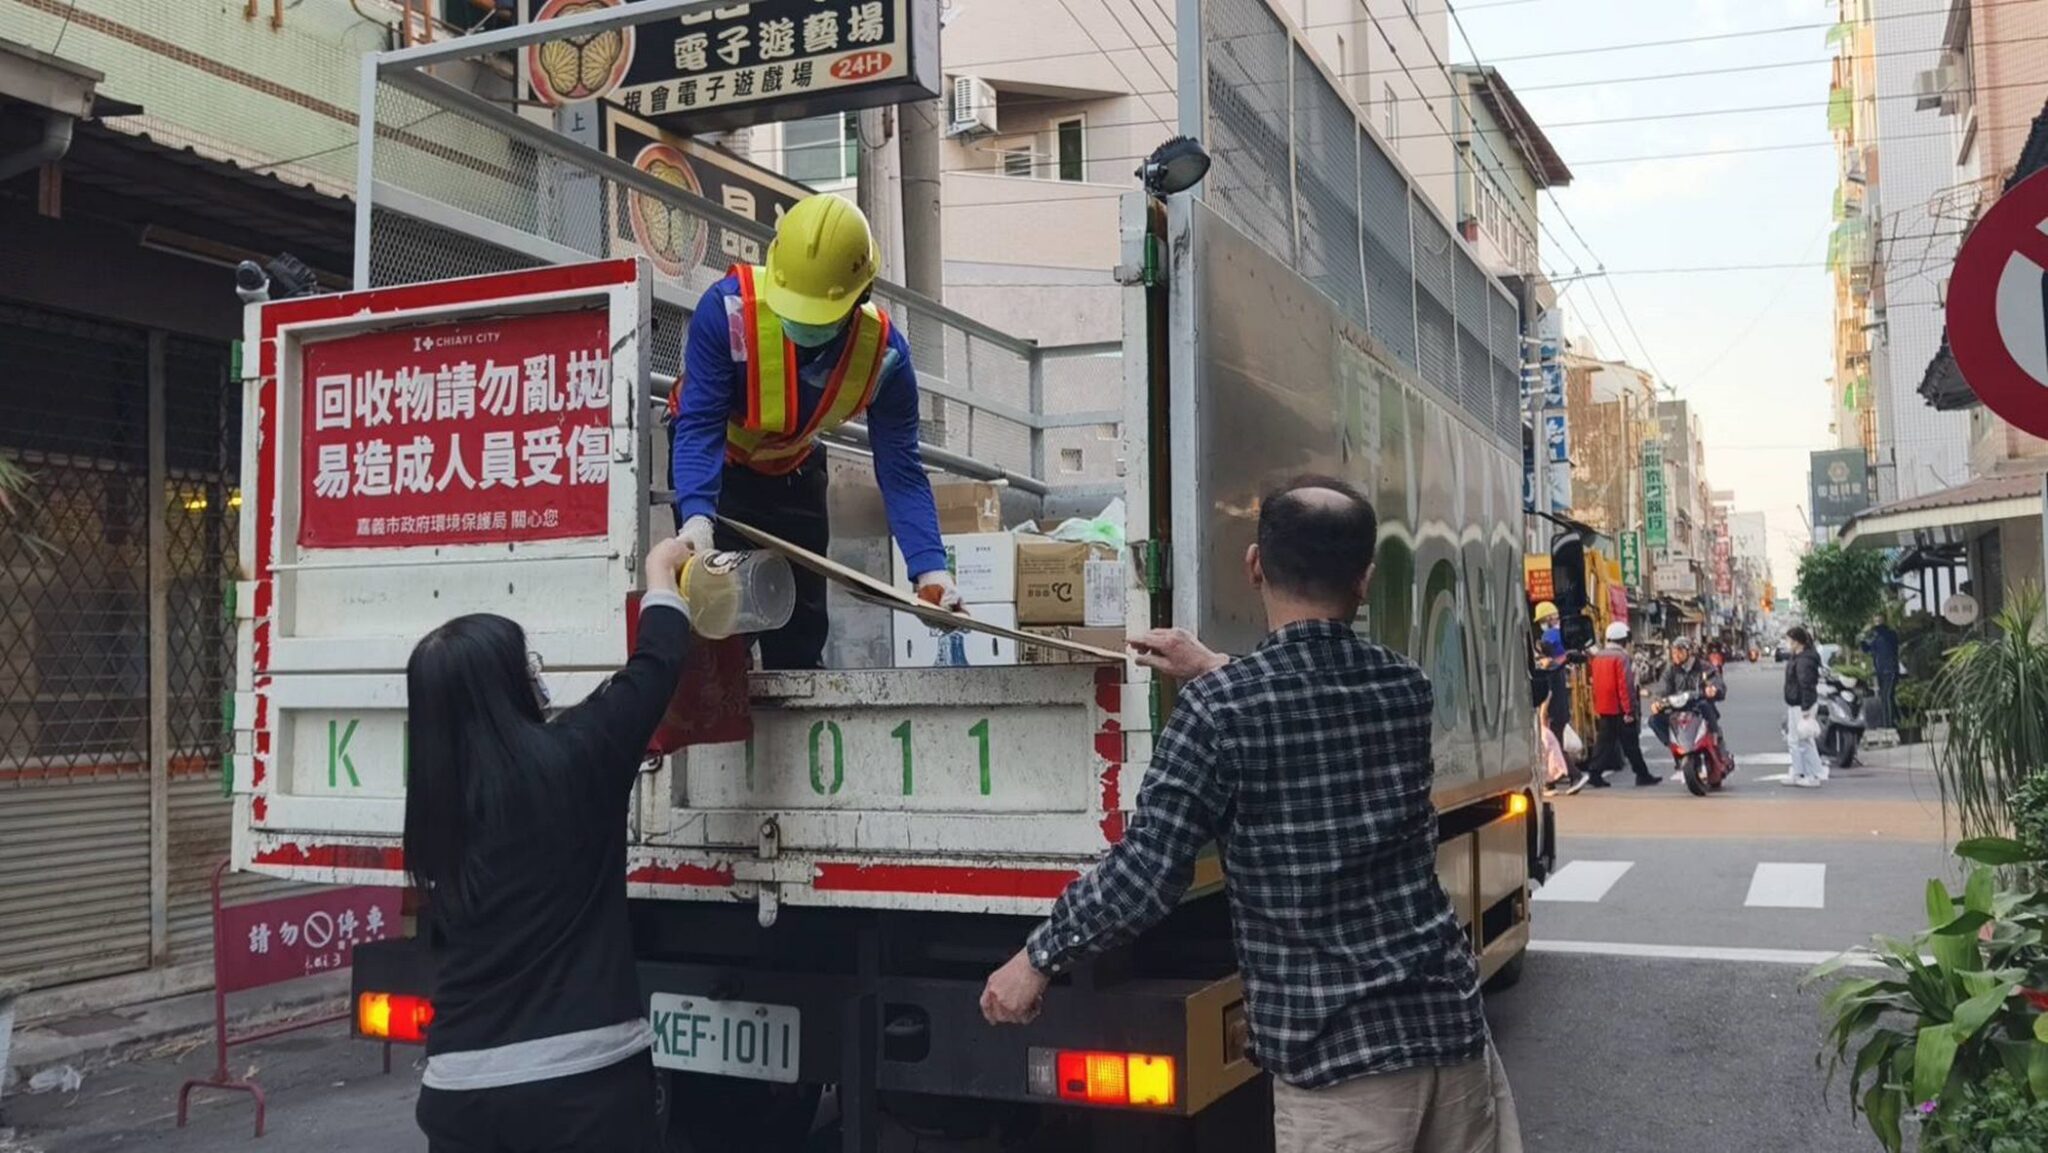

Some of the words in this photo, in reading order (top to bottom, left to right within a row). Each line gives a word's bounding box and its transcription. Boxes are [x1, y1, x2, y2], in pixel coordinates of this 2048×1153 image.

[674, 2, 884, 71] 電子遊藝場
[838, 53, 883, 78] 24H
[476, 332, 500, 344] CITY
[315, 348, 610, 431] 回收物請勿亂拋
[313, 424, 611, 499] 易造成人員受傷
[356, 511, 508, 535] 嘉義市政府環境保護局
[511, 508, 559, 528] 關心您
[248, 921, 299, 954] 請勿
[337, 904, 385, 940] 停車
